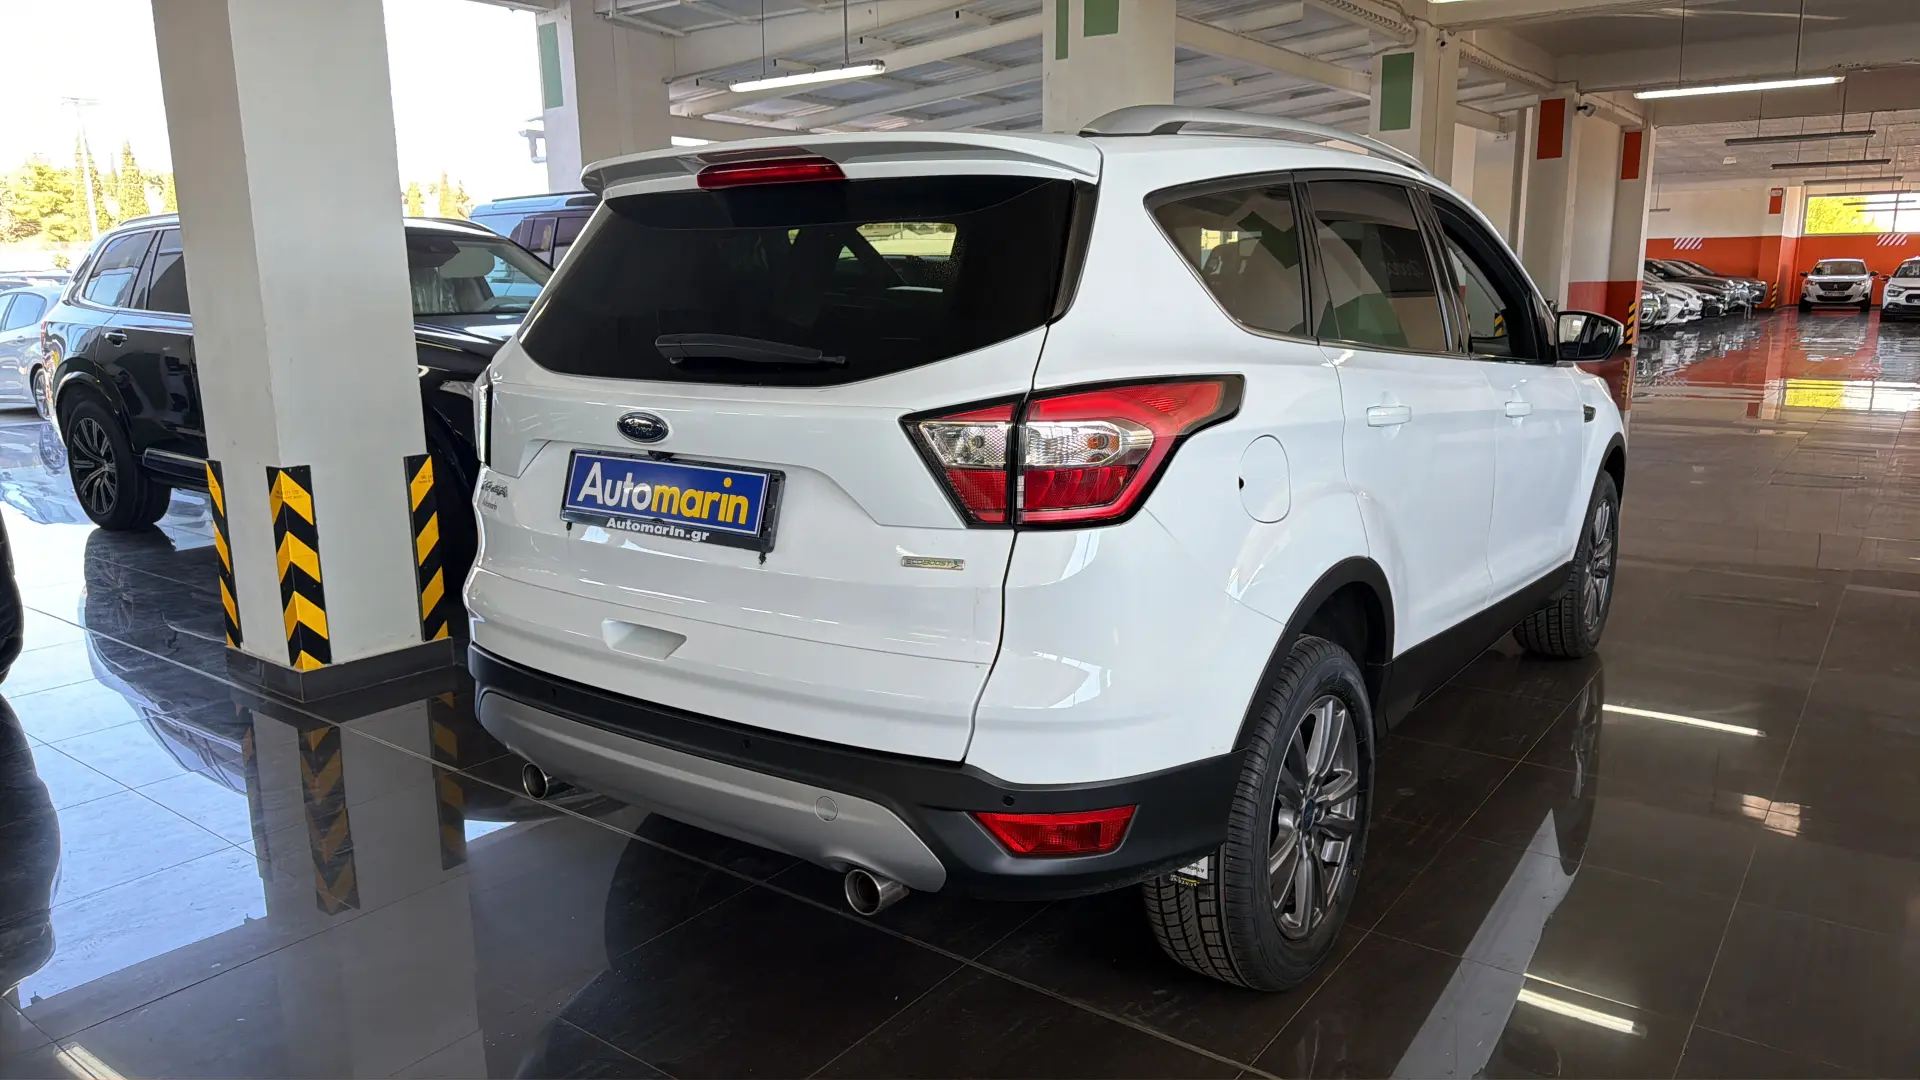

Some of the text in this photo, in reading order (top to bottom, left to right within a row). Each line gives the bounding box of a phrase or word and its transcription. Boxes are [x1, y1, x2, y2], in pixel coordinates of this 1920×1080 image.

[577, 462, 749, 525] Automarin
[606, 517, 710, 542] Automarin.gr
[906, 558, 952, 567] ECOBOOST
